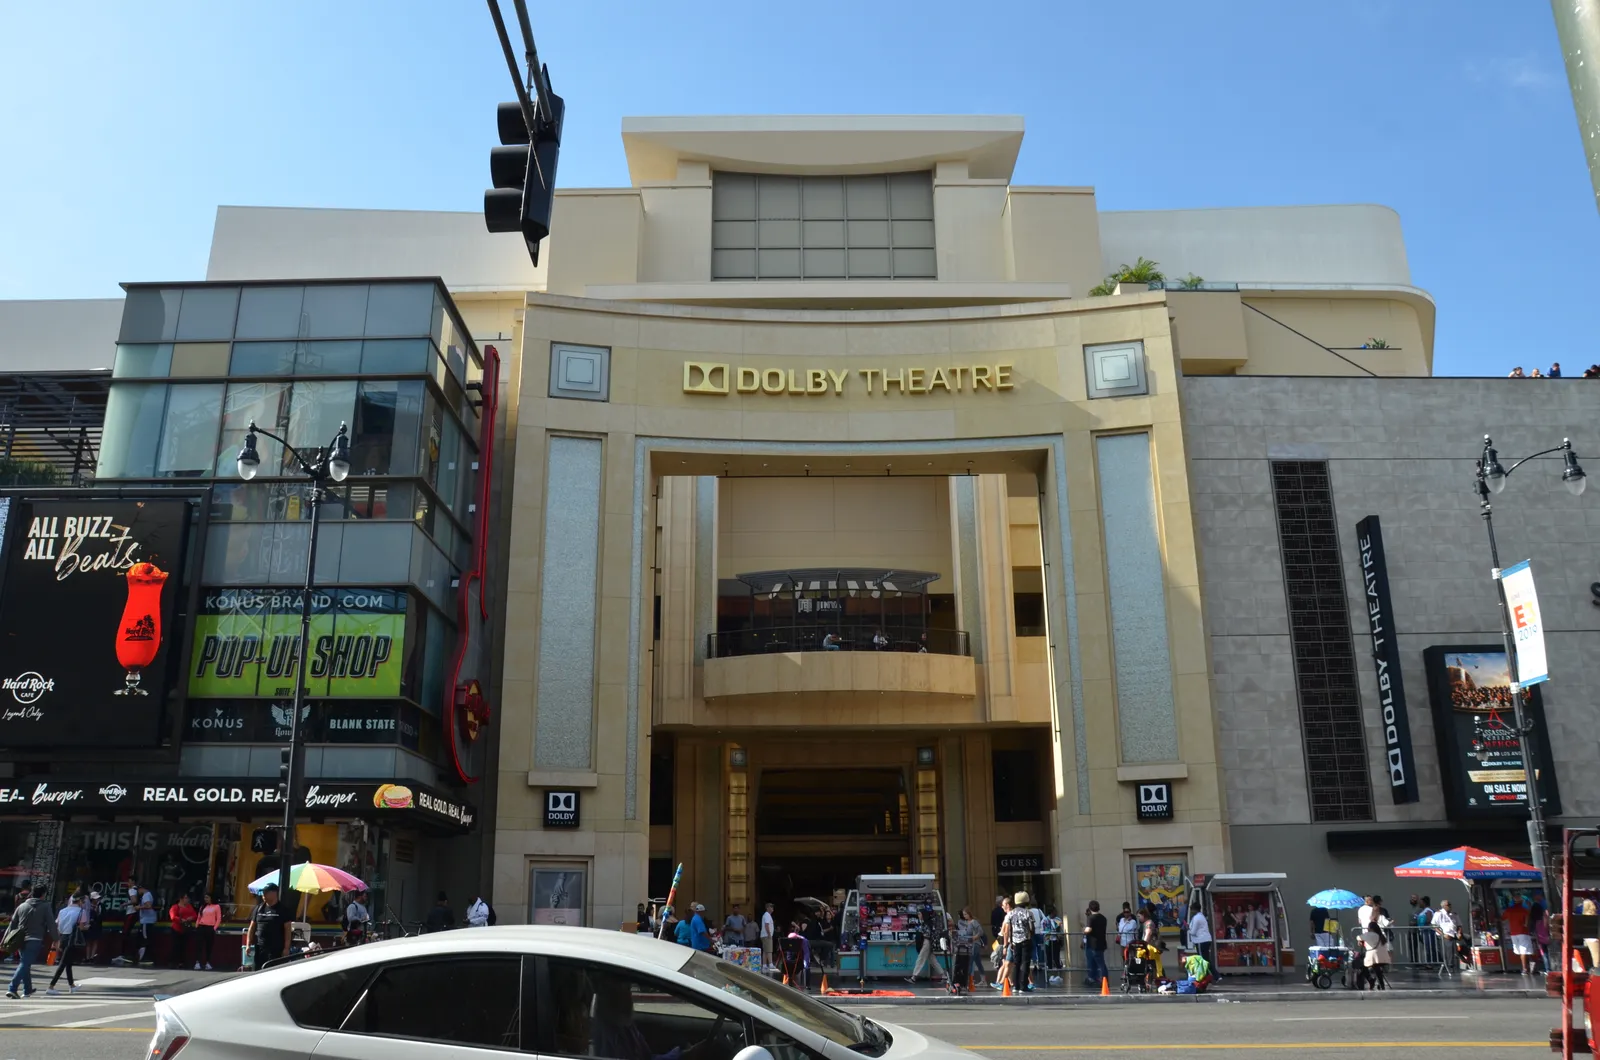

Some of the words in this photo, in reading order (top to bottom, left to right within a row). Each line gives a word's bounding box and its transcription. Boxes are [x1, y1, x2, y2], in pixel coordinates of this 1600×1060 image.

[737, 366, 849, 396] DOLBY
[858, 363, 1015, 396] THEATRE
[28, 516, 58, 538] ALL
[63, 516, 115, 538] BUZZ.
[24, 538, 55, 560] ALL
[205, 595, 265, 609] KONUS
[1360, 534, 1385, 651] THEATRE
[1513, 601, 1537, 629] E3
[310, 633, 393, 678] SHOP
[2, 678, 30, 690] Hard
[29, 678, 55, 692] Rock
[1376, 657, 1398, 745] DOLBY
[191, 718, 244, 728] KONUS
[329, 718, 362, 730] BLANK
[365, 718, 395, 730] STATE
[32, 783, 84, 806] Burger.
[143, 787, 188, 802] REAL
[193, 787, 246, 803] GOLD.
[304, 785, 358, 808] Burger.
[1483, 784, 1494, 794] ON
[1494, 784, 1511, 794] SALE
[1511, 783, 1527, 793] NOW
[419, 792, 433, 810] REAL
[448, 803, 460, 820] REAL
[1141, 804, 1168, 812] DOLBY
[81, 831, 131, 850] THIS
[167, 833, 198, 848] Hard
[1000, 859, 1038, 867] GUESS
